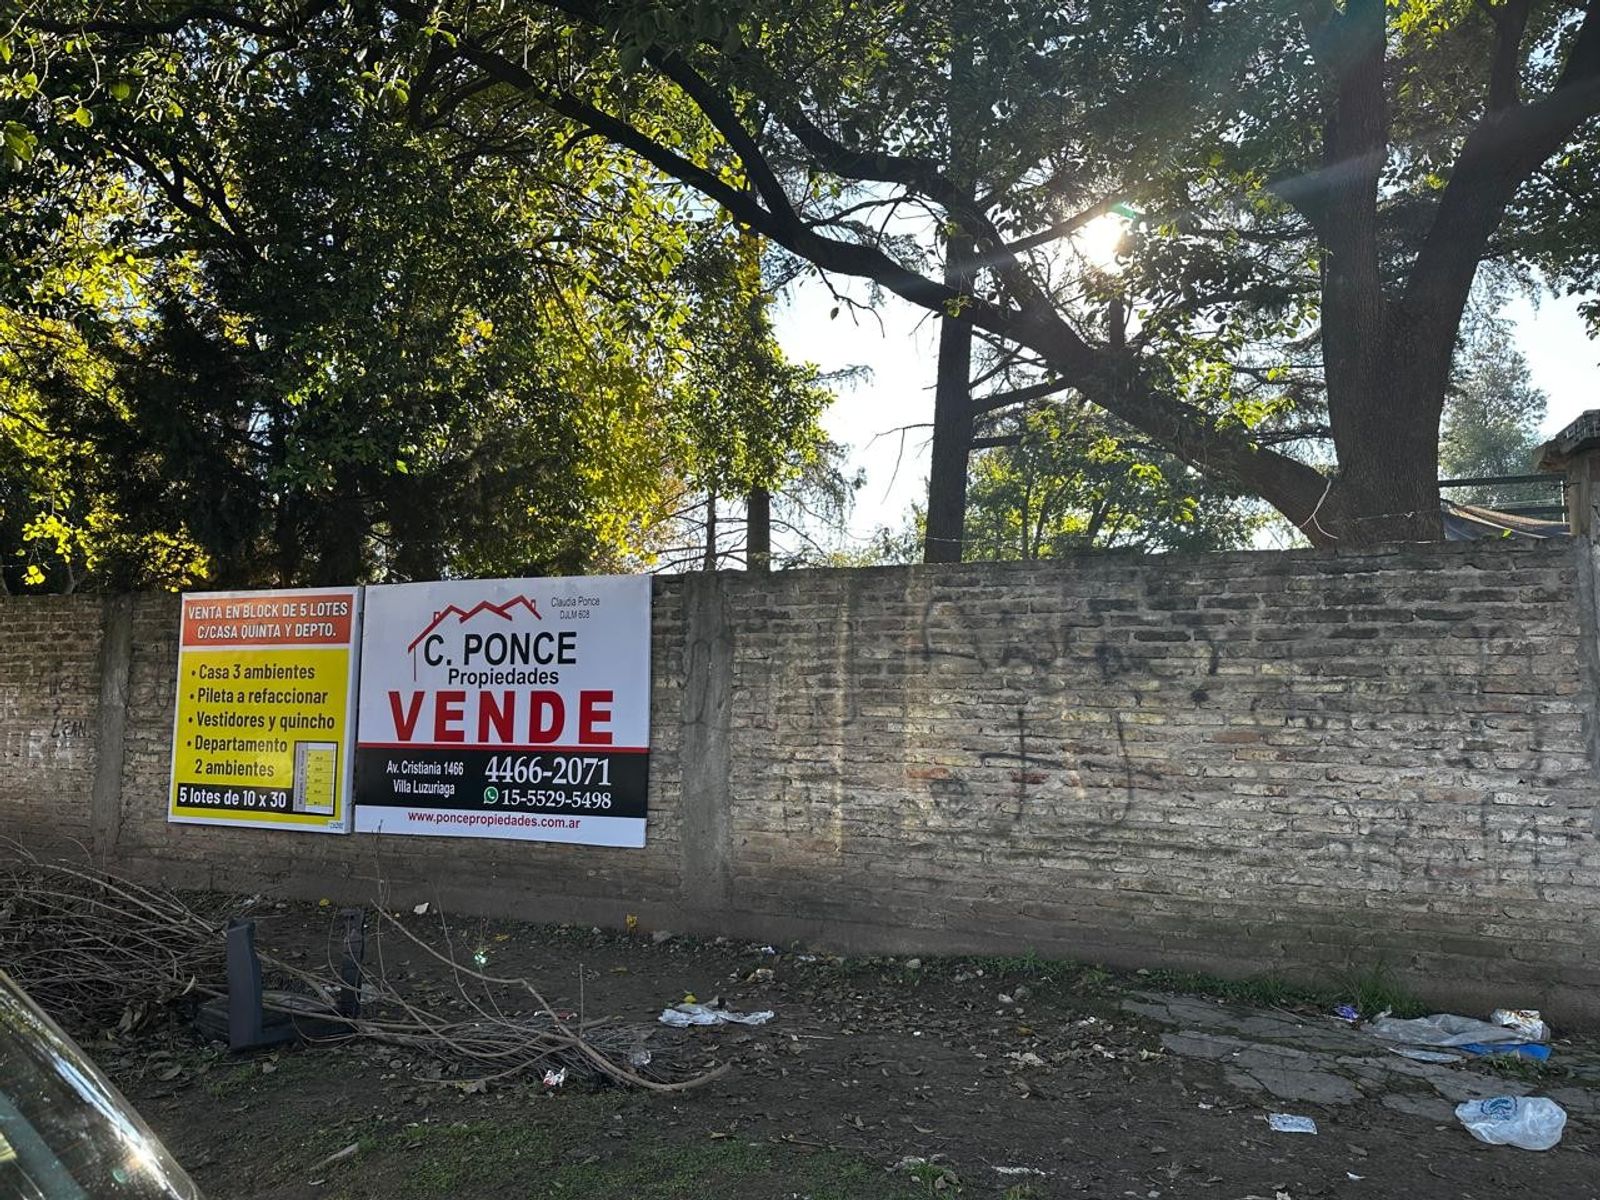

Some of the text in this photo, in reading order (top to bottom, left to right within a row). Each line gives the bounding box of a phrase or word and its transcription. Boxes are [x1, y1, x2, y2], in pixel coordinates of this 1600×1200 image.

[188, 602, 348, 619] VENTA EN BLOCK DE 5 LOTES
[551, 595, 600, 608] Claudia Ponce
[197, 622, 337, 639] C/CASA QUINTA Y DEPTO.
[424, 631, 577, 667] C. PONCE
[199, 664, 315, 679] Casa 3 ambientes
[448, 667, 559, 689] Propiedades
[197, 688, 328, 704] Pileta a refaccionar
[197, 711, 335, 732] Vestidores y quincho
[388, 690, 614, 745] VENDE
[195, 735, 288, 754] Departamento
[195, 758, 275, 777] 2 ambientes
[386, 760, 464, 776] Av. Cristiania 1466
[485, 756, 612, 786] 4466-2071
[179, 786, 287, 808] 5 lotes de 10 x 30
[393, 779, 455, 798] Villa Luzuriaga
[501, 789, 612, 809] 15-5529-5498
[408, 812, 581, 829] www.poncepropiedades.com.ar
